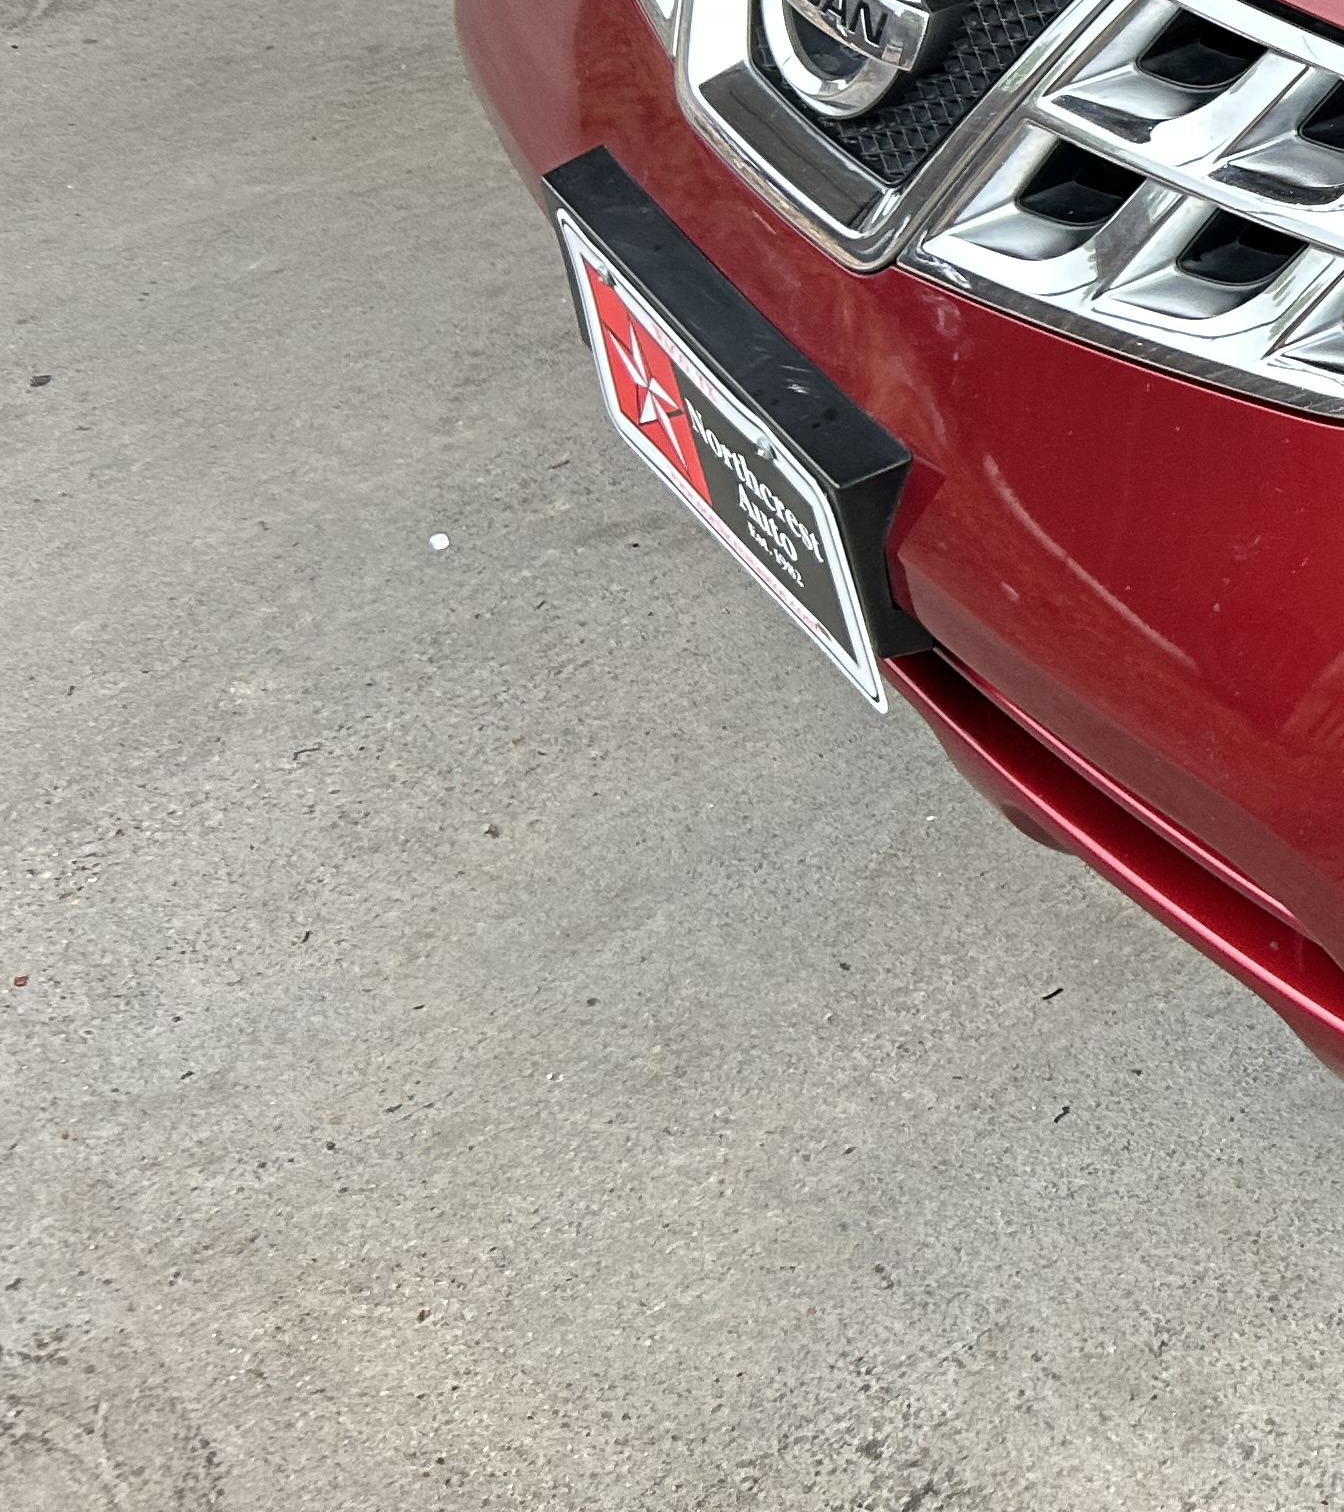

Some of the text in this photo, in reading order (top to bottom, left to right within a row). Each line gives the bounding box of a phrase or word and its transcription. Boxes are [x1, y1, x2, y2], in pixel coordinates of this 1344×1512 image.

[684, 397, 824, 563] Northcrest
[738, 483, 798, 562] Auto
[747, 521, 805, 587] Est. 1982
